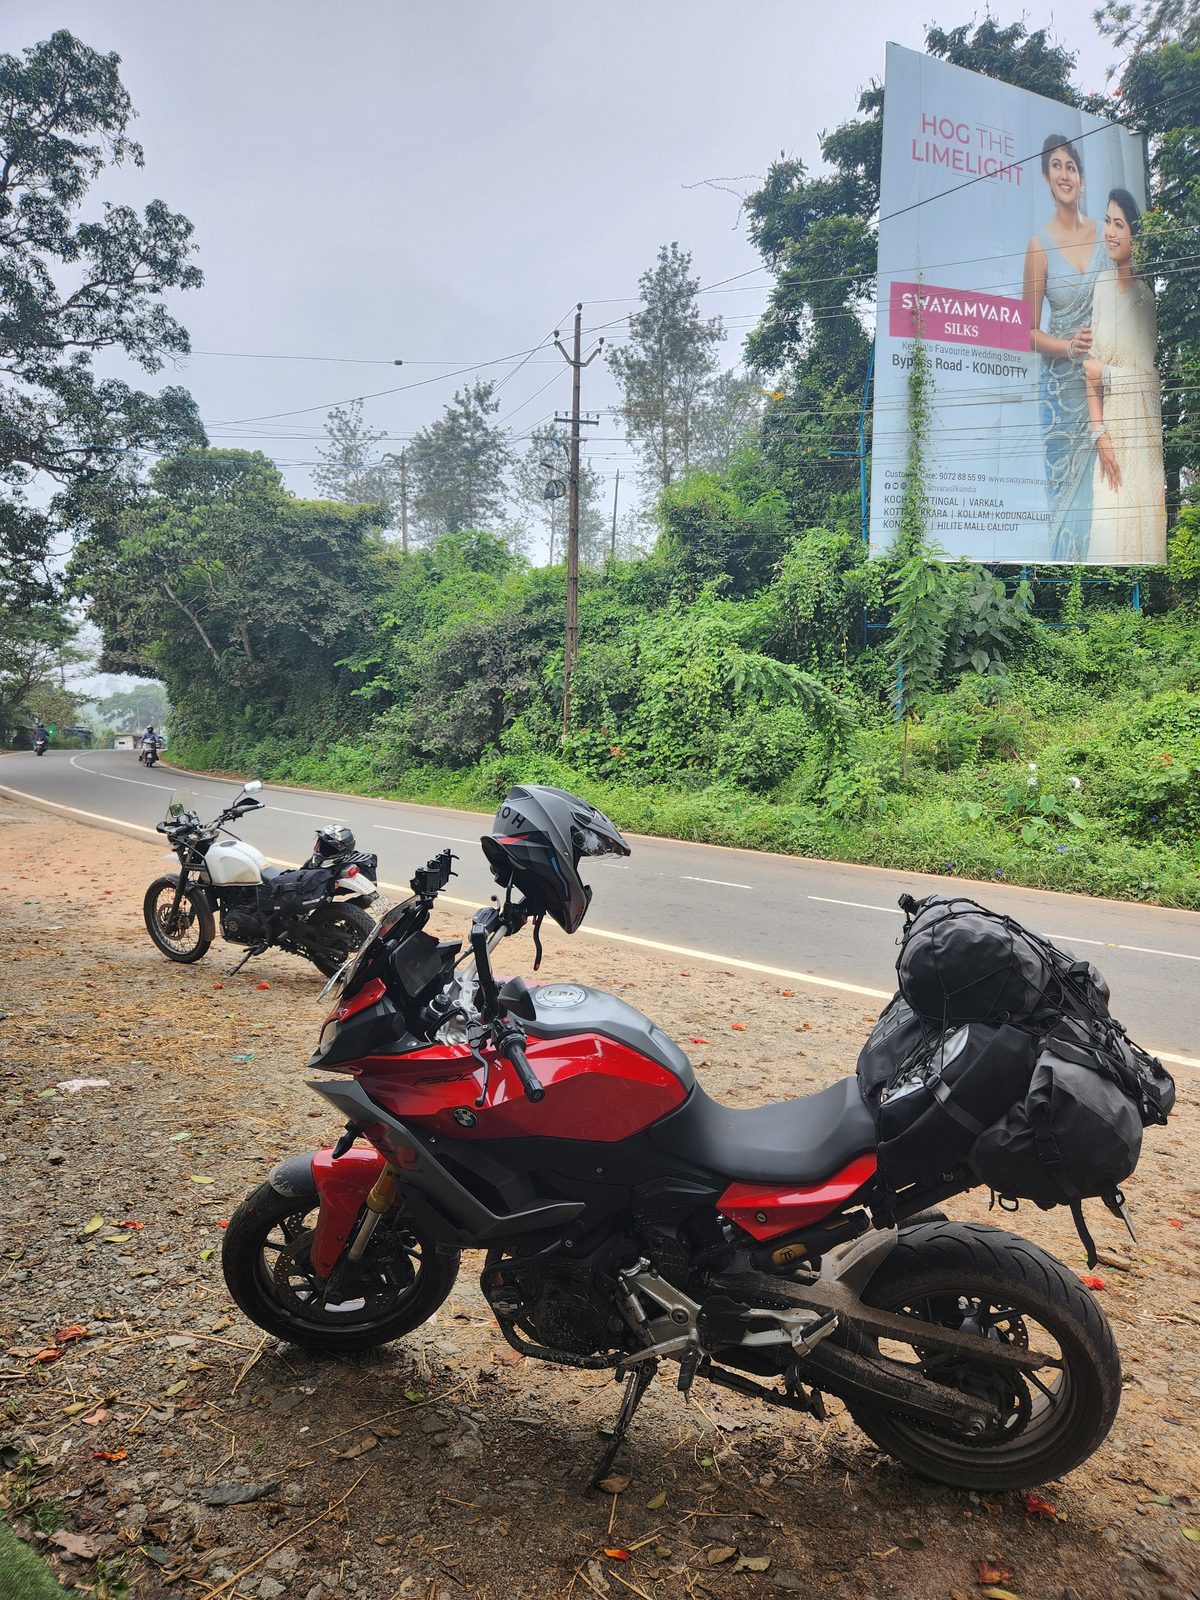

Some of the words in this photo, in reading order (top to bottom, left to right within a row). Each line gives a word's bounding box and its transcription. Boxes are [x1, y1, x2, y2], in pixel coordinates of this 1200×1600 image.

[921, 113, 970, 145] HOG
[976, 127, 1015, 158] THE
[911, 138, 1023, 186] LIMELIGHT
[901, 293, 1022, 325] SWAYAMVARA
[944, 322, 979, 338] SILKS
[935, 344, 970, 357] Favourite
[971, 349, 1002, 363] Wedding
[1003, 352, 1021, 363] Store
[936, 357, 962, 371] Road
[972, 361, 1028, 379] KONDOTTY
[939, 472, 957, 481] 9072
[957, 472, 966, 481] 88
[967, 473, 976, 481] 55
[977, 474, 986, 482] 99
[884, 495, 909, 504] KOCH
[969, 498, 1004, 508] VARKALA
[957, 510, 990, 520] KOLLAM
[995, 511, 1051, 522] KODUNGALLUR
[937, 521, 962, 530] HILITE
[964, 522, 985, 531] MALL
[987, 522, 1019, 531] CALICUT
